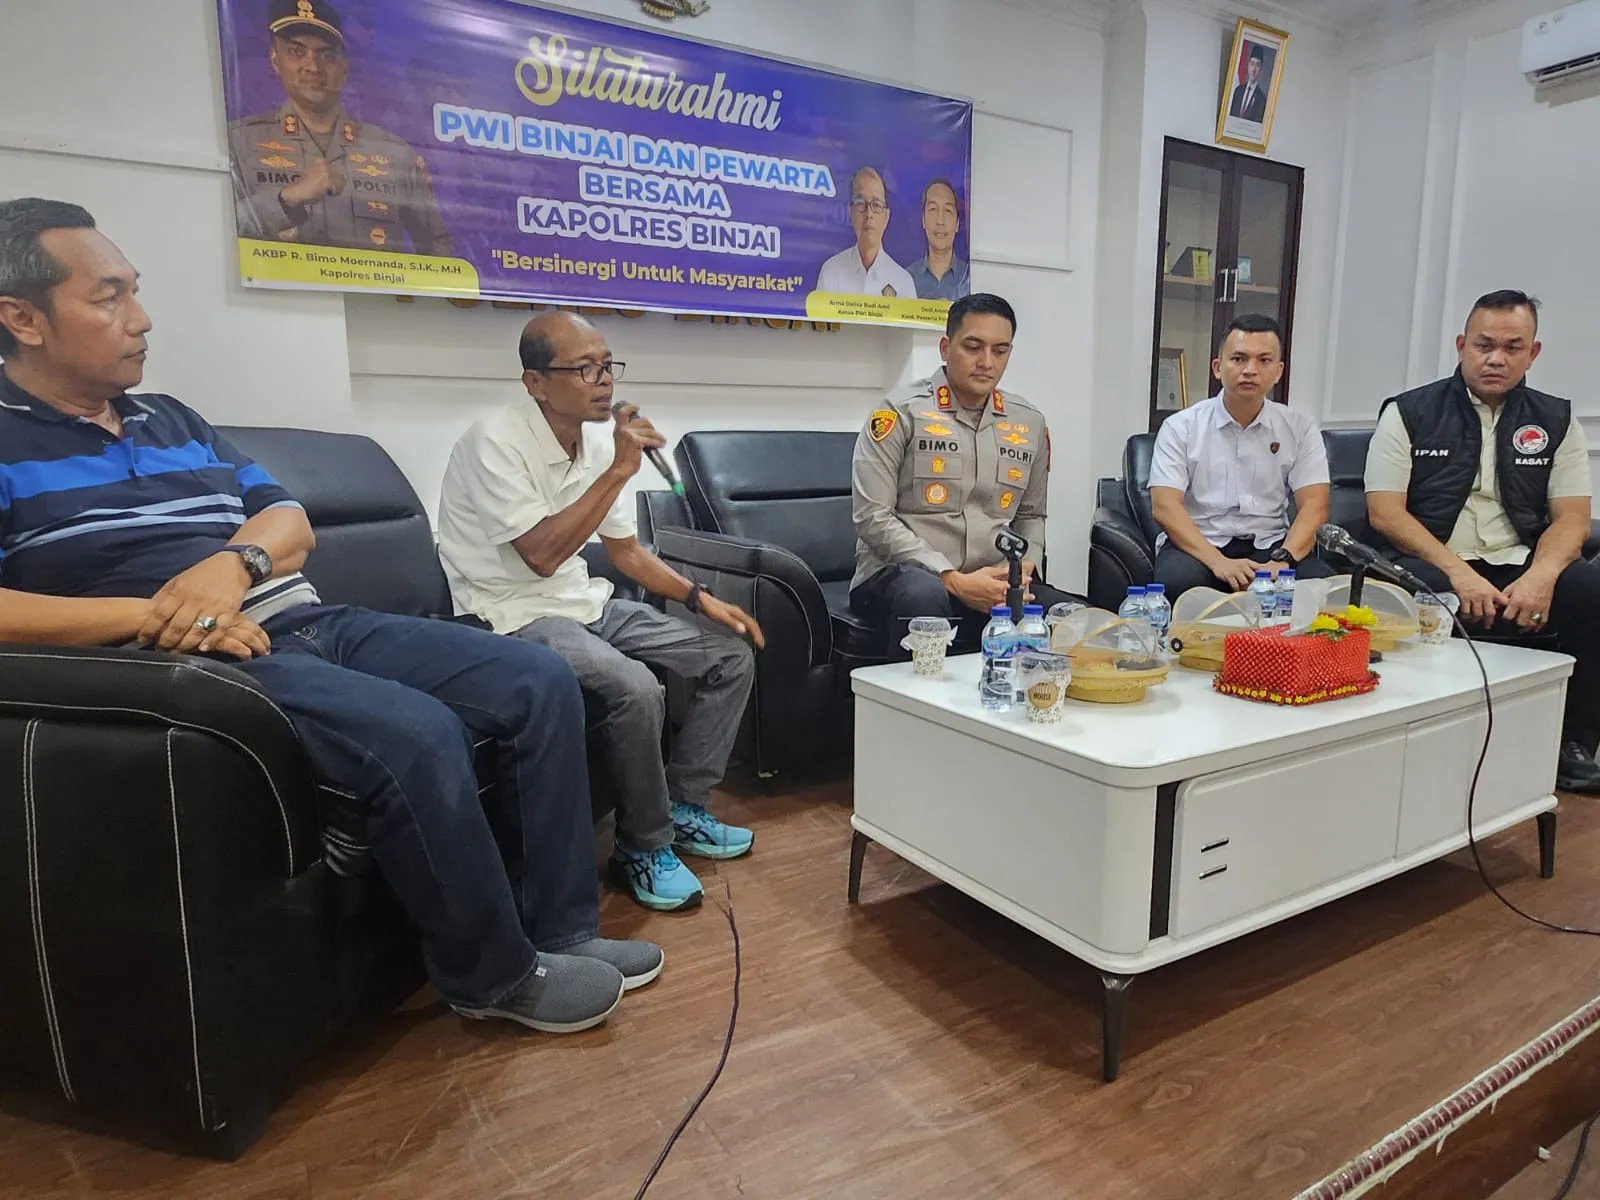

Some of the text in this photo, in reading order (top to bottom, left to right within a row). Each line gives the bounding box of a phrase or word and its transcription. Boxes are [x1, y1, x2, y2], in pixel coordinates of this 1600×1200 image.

[514, 34, 783, 131] Silaturahmi
[438, 108, 833, 194] PWI BINJAI DAN PEWARTA
[352, 179, 397, 196] POLRI
[582, 169, 729, 214] BERSAMA
[521, 201, 778, 255] KAPOLRES BINJAI
[252, 247, 462, 275] AKBP R. Bimo Moernanda, S.I.K., M.H
[491, 249, 617, 280] "Bersinergi
[622, 260, 685, 284] Untuk
[319, 267, 406, 284] Kapolres Binjai
[918, 439, 959, 452] BIMO
[1000, 446, 1033, 464] POLRI
[1515, 457, 1550, 466] KASAT
